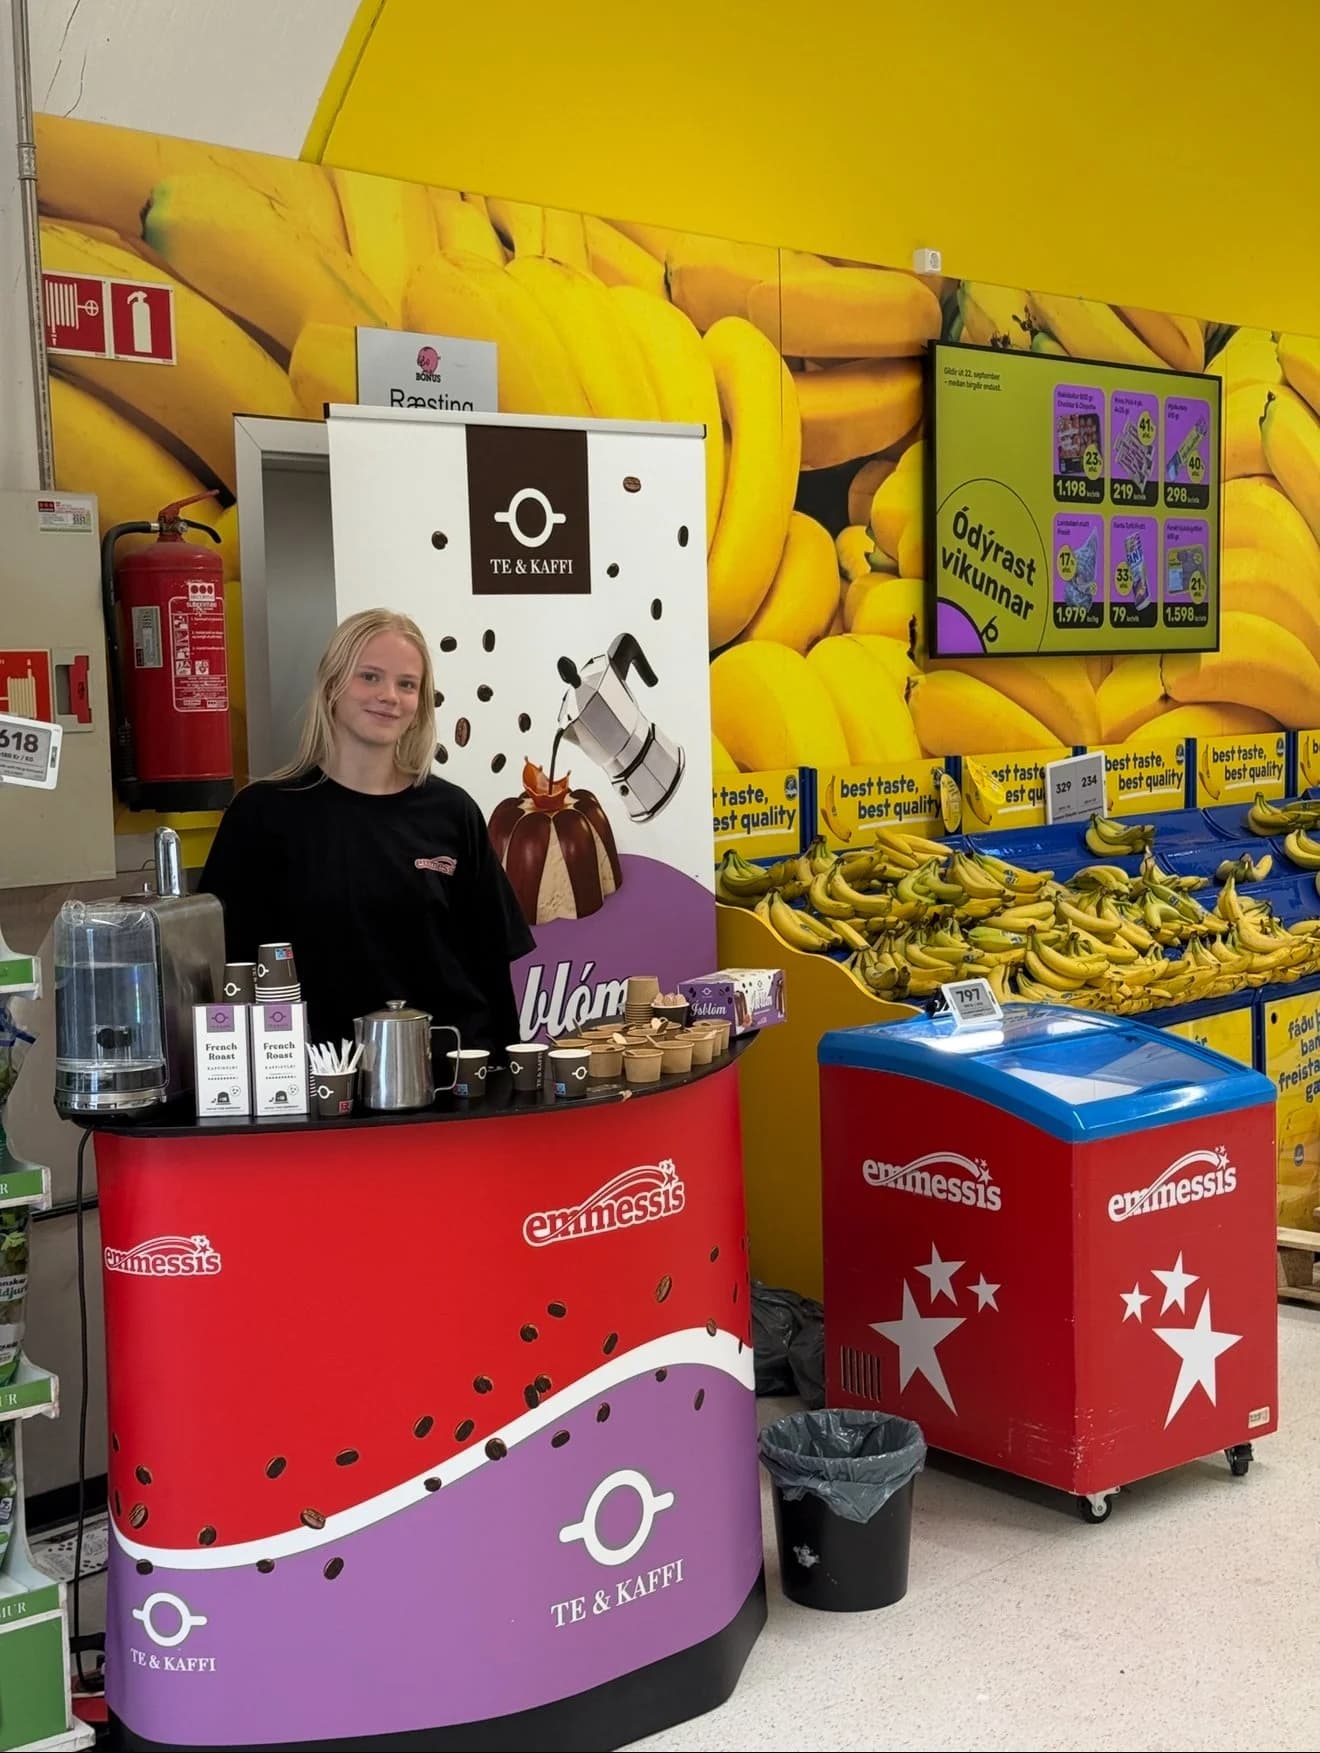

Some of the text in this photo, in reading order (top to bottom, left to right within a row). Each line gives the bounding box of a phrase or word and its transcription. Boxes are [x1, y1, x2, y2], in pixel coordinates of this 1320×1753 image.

[415, 370, 442, 383] BÓNUS
[1056, 480, 1086, 497] 1.198
[1113, 484, 1133, 499] 219
[1166, 487, 1187, 503] 298
[952, 505, 1036, 587] Ódýrast
[490, 558, 573, 575] TE & KAFFI
[941, 546, 1035, 620] vikunnar
[1056, 606, 1086, 622] 1.979
[1113, 607, 1126, 622] 79
[1166, 607, 1194, 622] 1.598
[1105, 751, 1165, 772] best taste,
[1212, 743, 1267, 763] best taste,
[991, 761, 1046, 784] est taste
[1081, 774, 1097, 788] 234
[1118, 768, 1184, 794] best quality
[1225, 761, 1284, 784] best quality
[840, 772, 919, 798] best taste,
[1005, 784, 1026, 803] est
[1055, 781, 1072, 794] 329
[720, 785, 768, 808] taste,
[858, 799, 891, 819] best
[893, 795, 942, 821] quality
[713, 806, 796, 834] est quality
[519, 960, 629, 1042] blóm
[956, 988, 981, 1003] 797
[690, 999, 727, 1017] Ísblóm
[1288, 1016, 1314, 1040] fáðu
[205, 1043, 238, 1052] French
[263, 1041, 296, 1050] French
[266, 1051, 293, 1060] Roast
[1301, 1035, 1320, 1056] ban
[208, 1053, 236, 1061] Roast
[862, 1153, 1002, 1212] emmessis
[1107, 1156, 1238, 1223] emmessis
[523, 1172, 685, 1248] emmessis
[104, 1240, 222, 1277] emmessis
[551, 1558, 685, 1629] TE & KAFFI
[130, 1648, 216, 1672] TE & KAFFI
